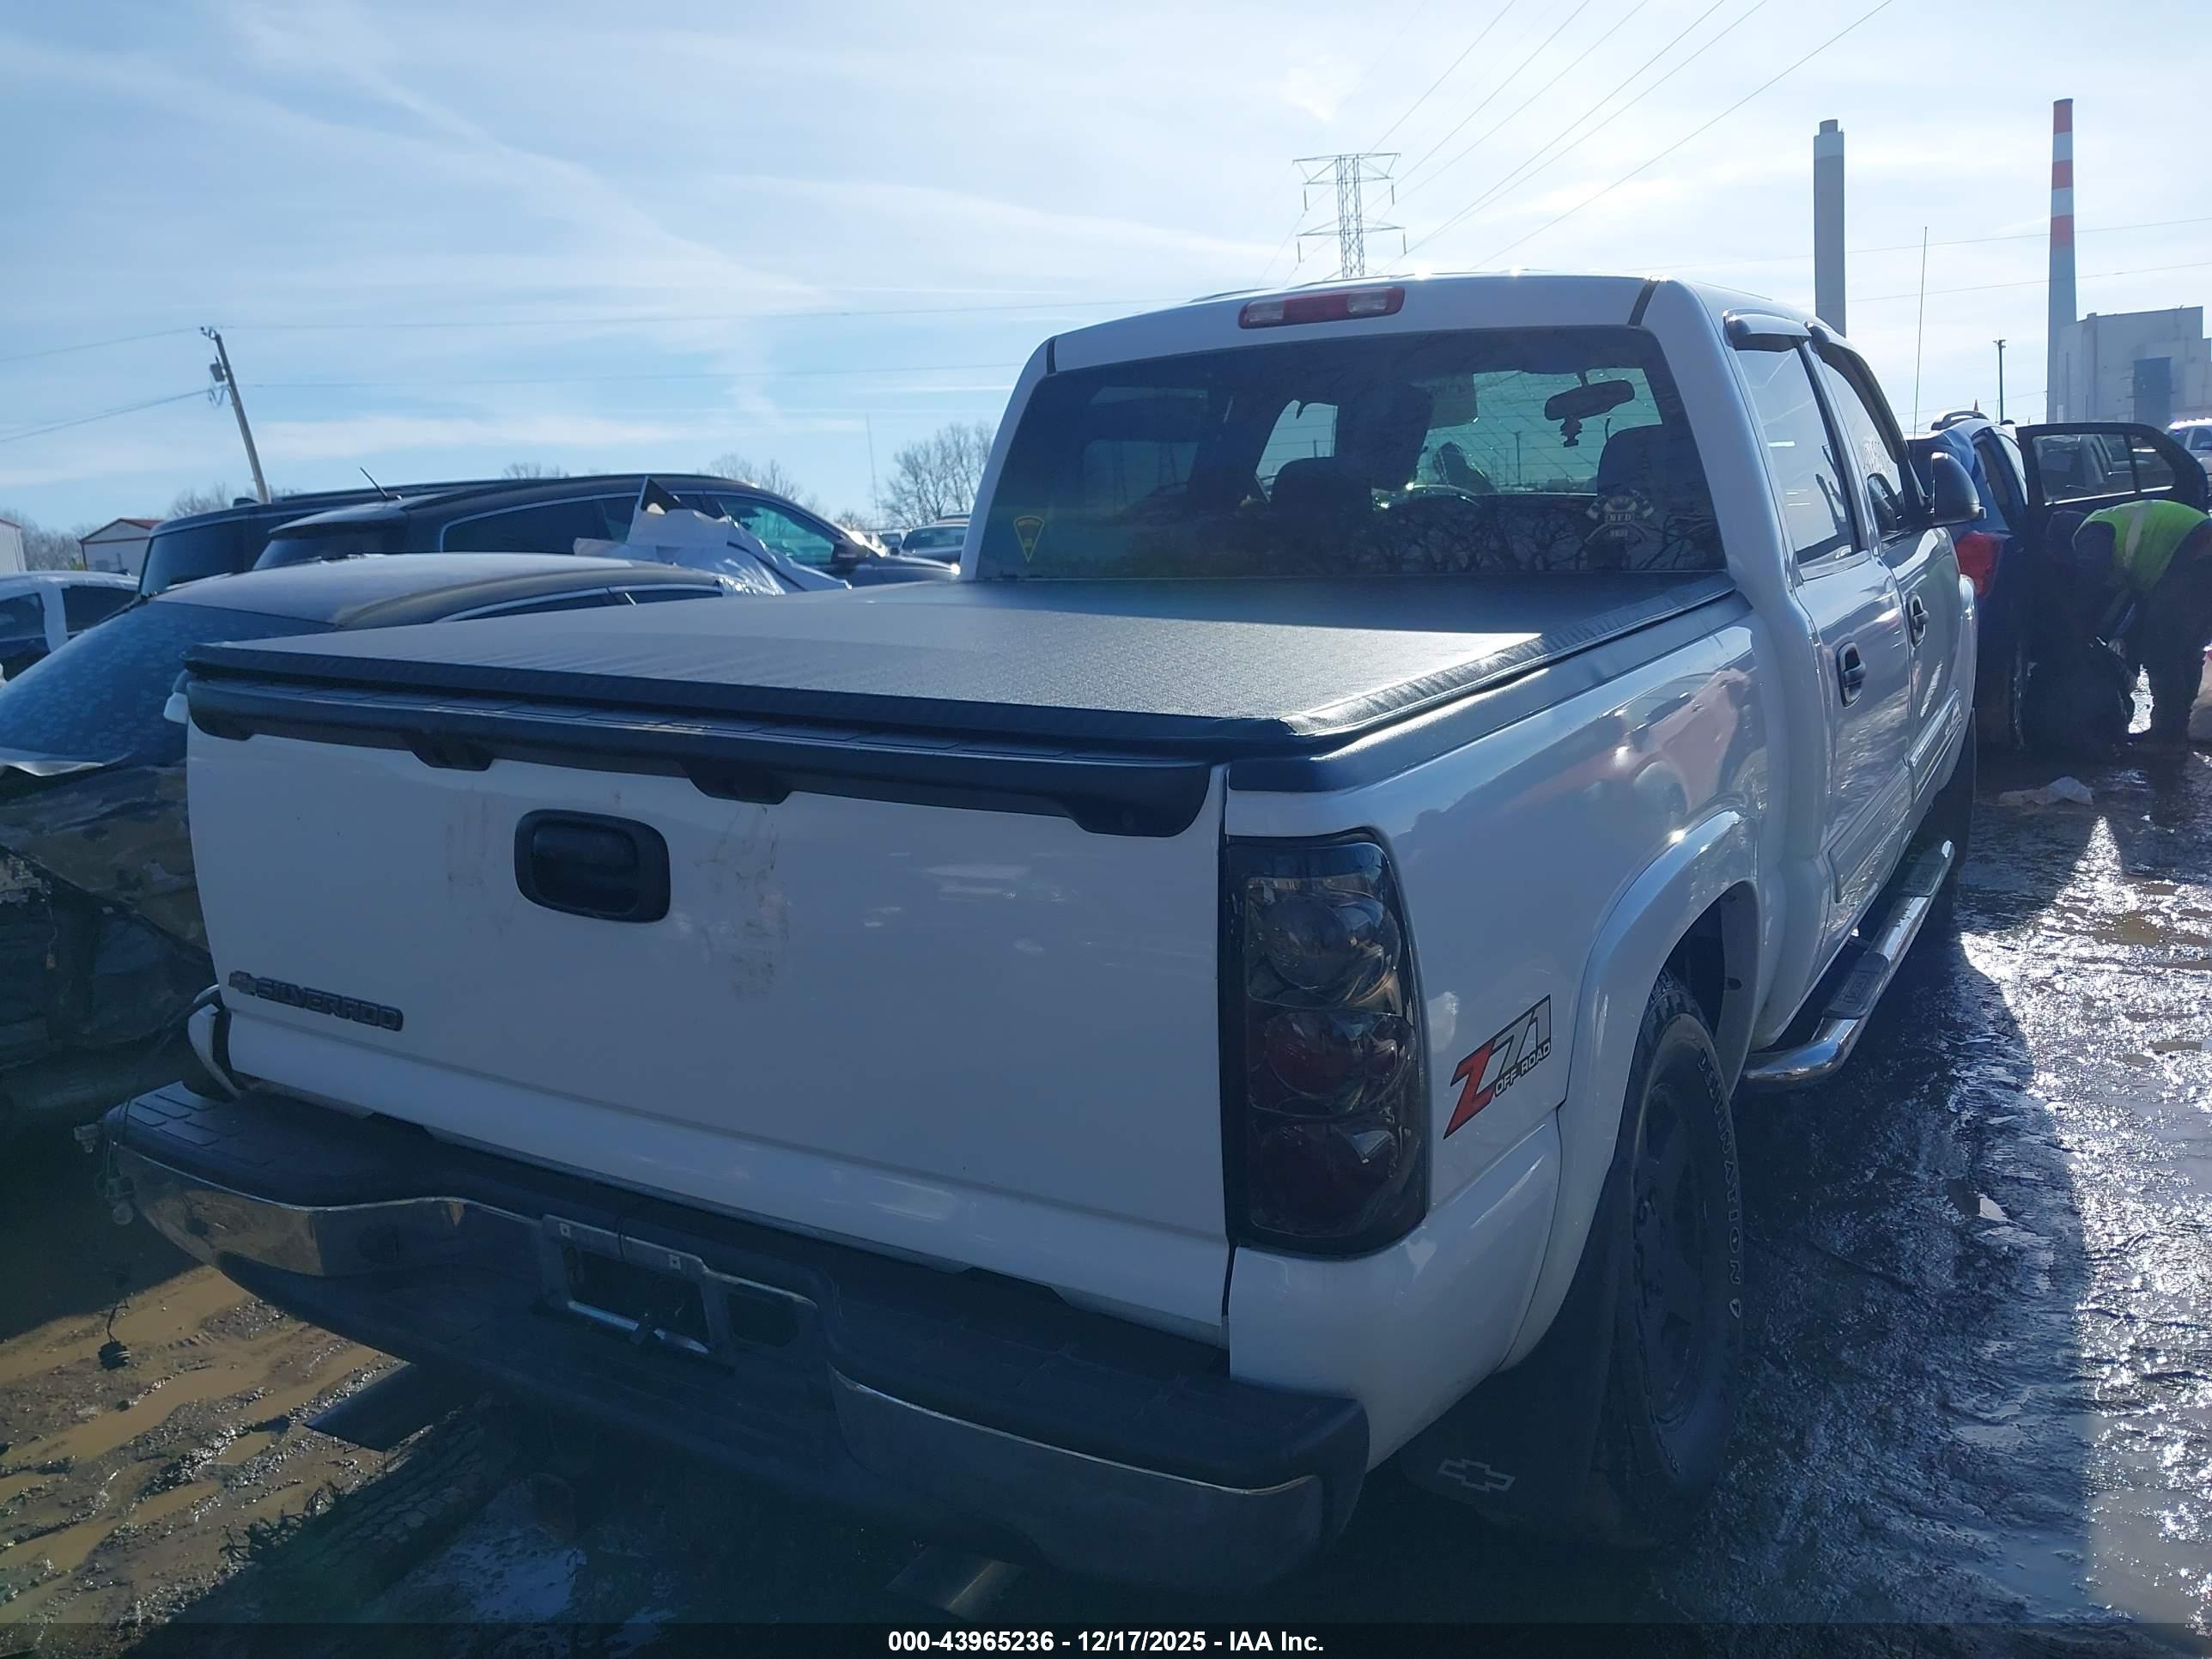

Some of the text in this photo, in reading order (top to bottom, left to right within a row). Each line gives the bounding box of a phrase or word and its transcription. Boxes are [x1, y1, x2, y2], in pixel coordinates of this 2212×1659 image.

[256, 976, 404, 1031] SILVERADO
[1443, 994, 1552, 1139] Z71
[1494, 1042, 1551, 1096] OFF ROAD
